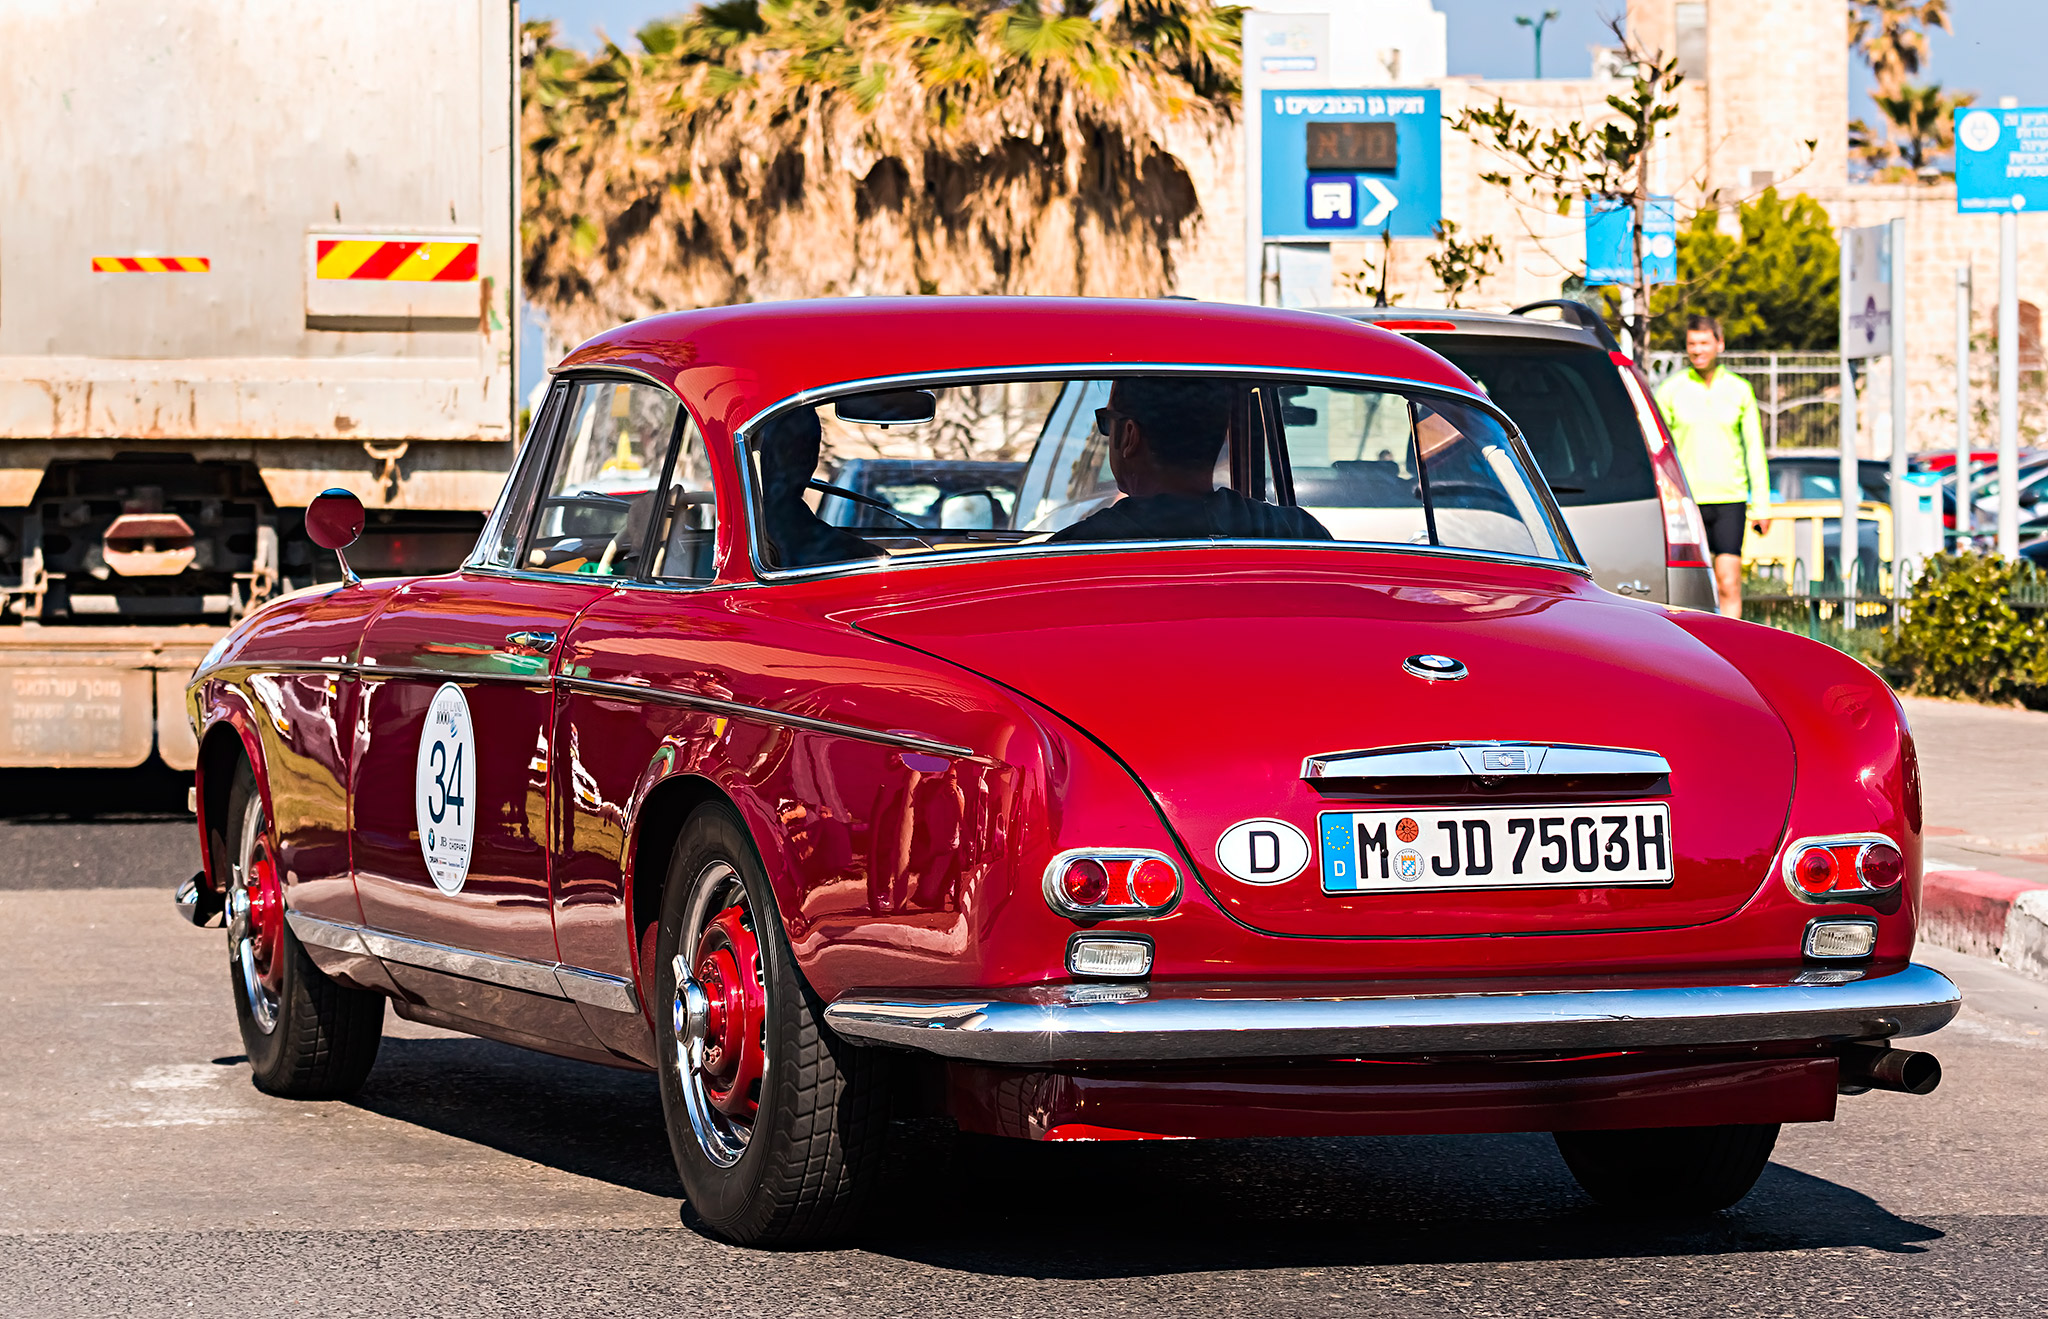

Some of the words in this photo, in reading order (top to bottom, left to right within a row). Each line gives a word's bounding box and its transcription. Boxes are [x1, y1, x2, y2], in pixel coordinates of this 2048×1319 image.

[1367, 96, 1386, 116] גן
[428, 740, 464, 826] 34
[1249, 830, 1280, 874] D
[1333, 860, 1346, 877] D
[1358, 822, 1389, 880] M
[1431, 820, 1493, 877] JD
[1507, 814, 1667, 875] 7503H
